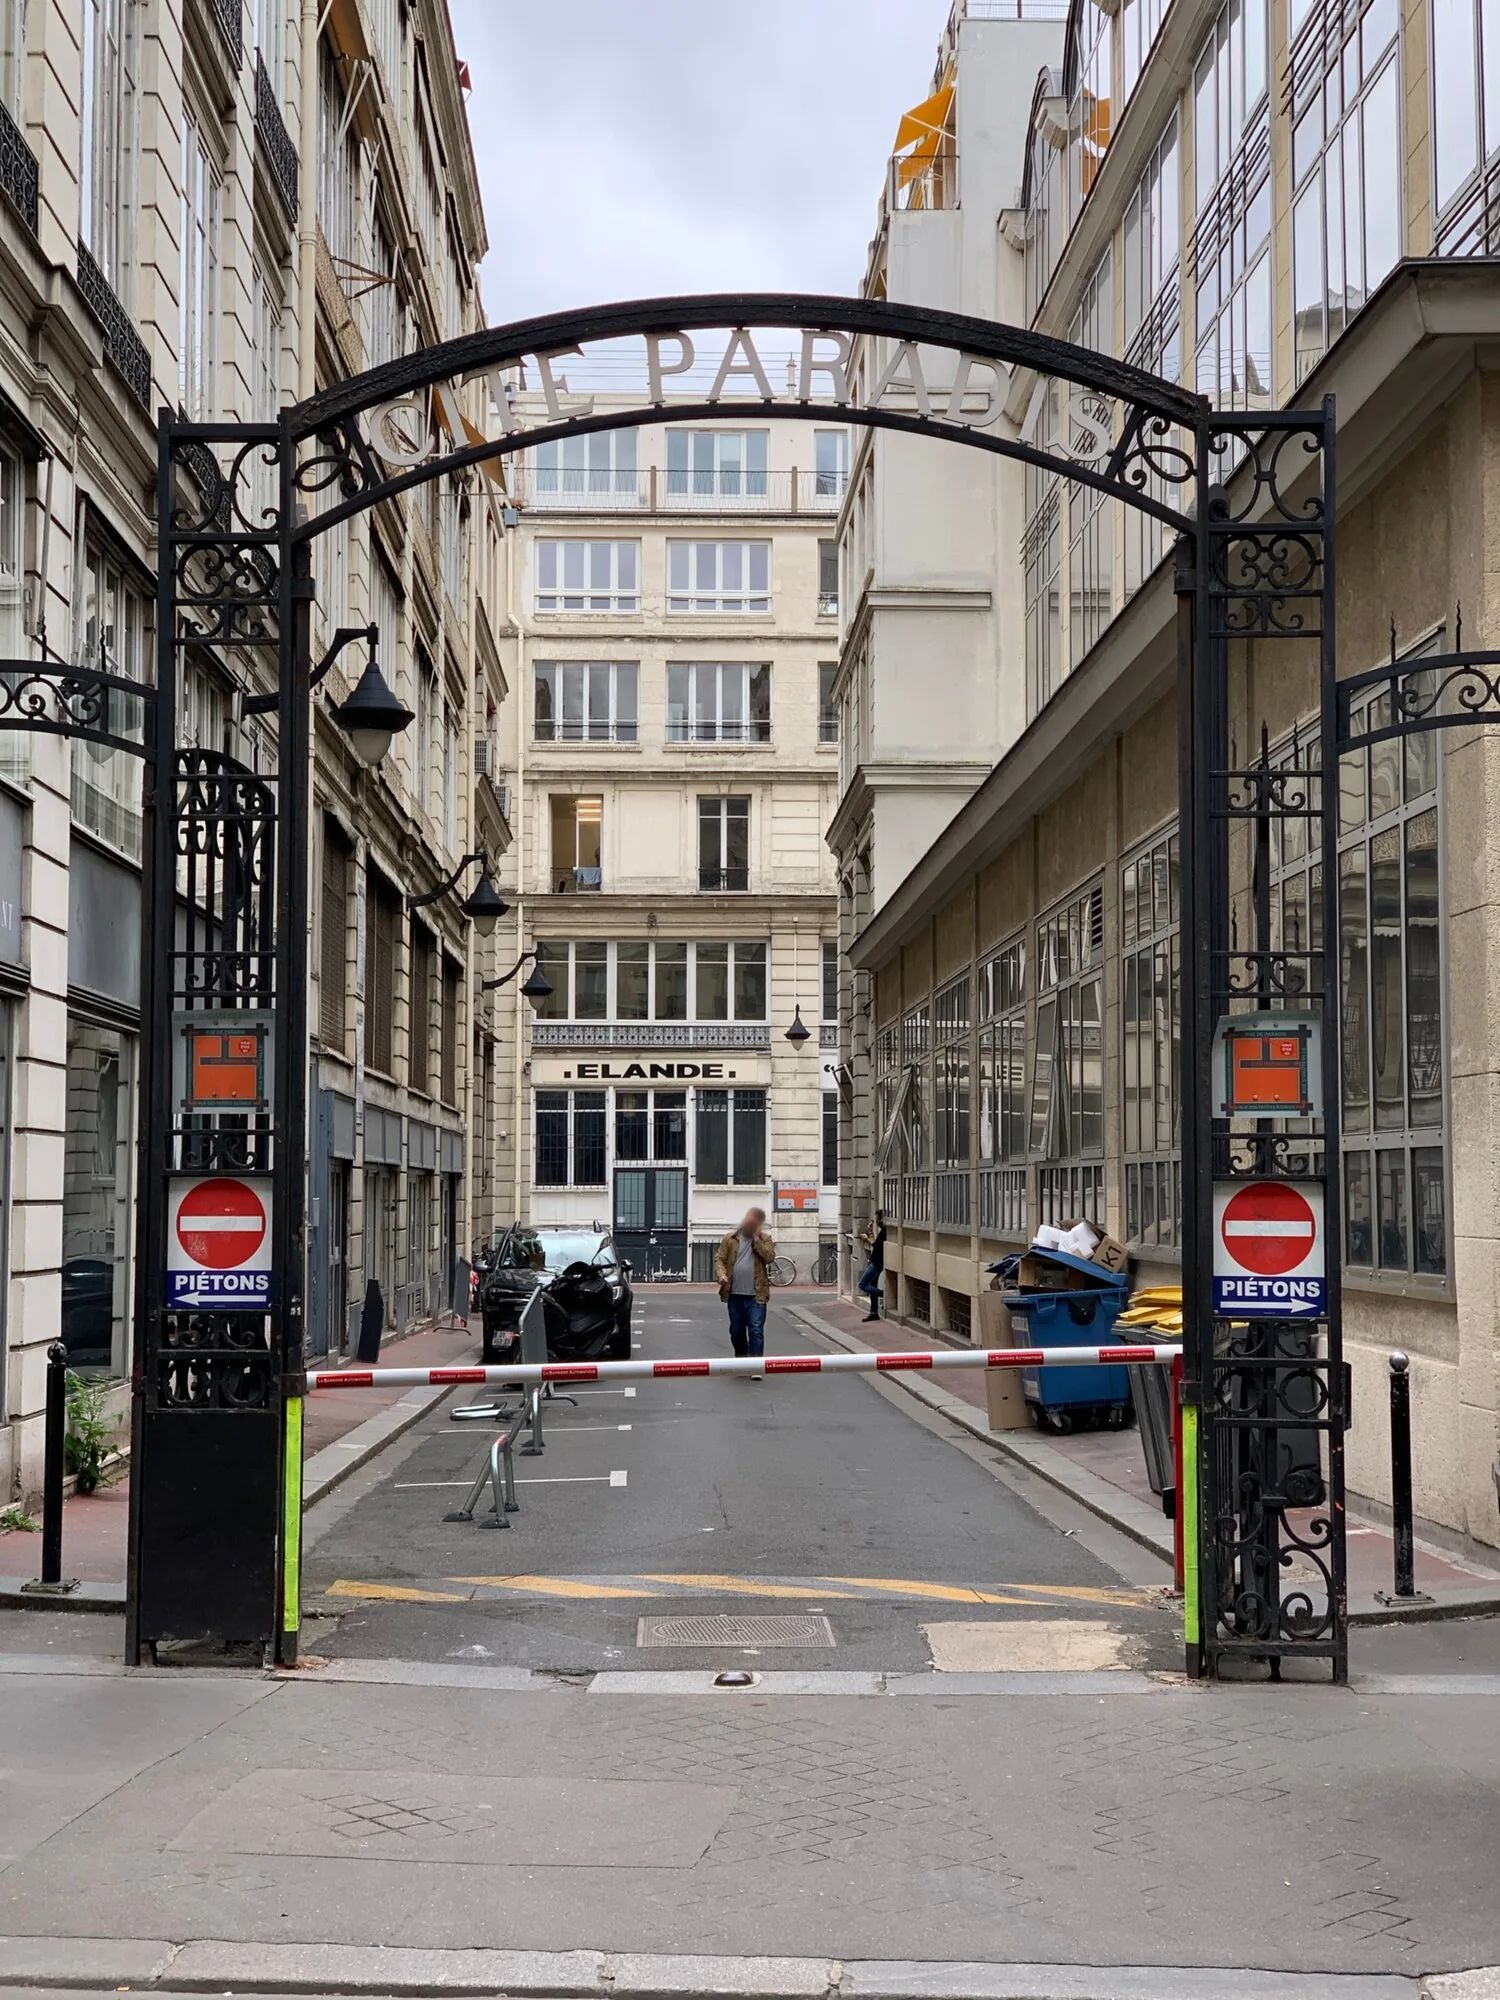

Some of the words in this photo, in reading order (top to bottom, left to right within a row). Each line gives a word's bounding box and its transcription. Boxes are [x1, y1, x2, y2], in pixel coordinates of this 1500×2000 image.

[369, 343, 595, 467] CITE
[643, 328, 1111, 463] PARADIS
[1101, 1245, 1122, 1268] K1
[175, 1271, 269, 1291] PIÉTONS
[1222, 1277, 1321, 1298] PIÉTONS
